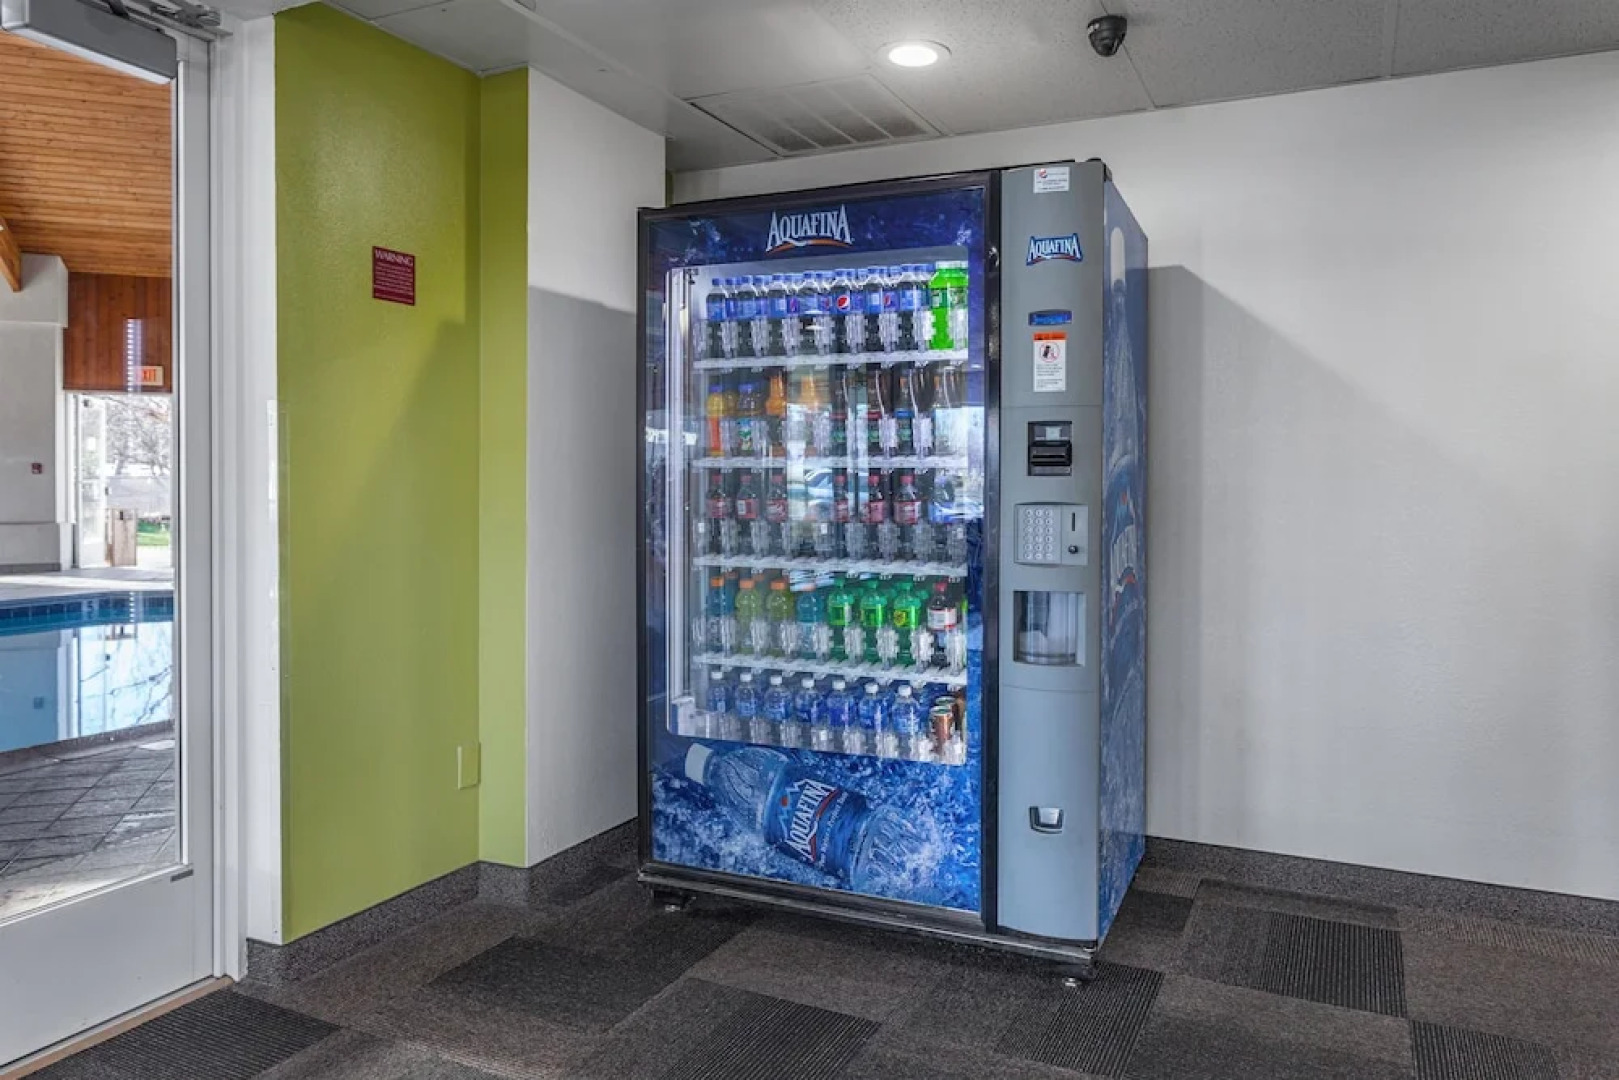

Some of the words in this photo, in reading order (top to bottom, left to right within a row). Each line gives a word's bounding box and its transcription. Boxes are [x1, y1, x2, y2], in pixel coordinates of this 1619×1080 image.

[765, 203, 852, 252] AQUAFINA
[375, 249, 414, 266] WARNING
[1027, 234, 1081, 263] AQUAFINA
[784, 778, 838, 862] AQUAFINA
